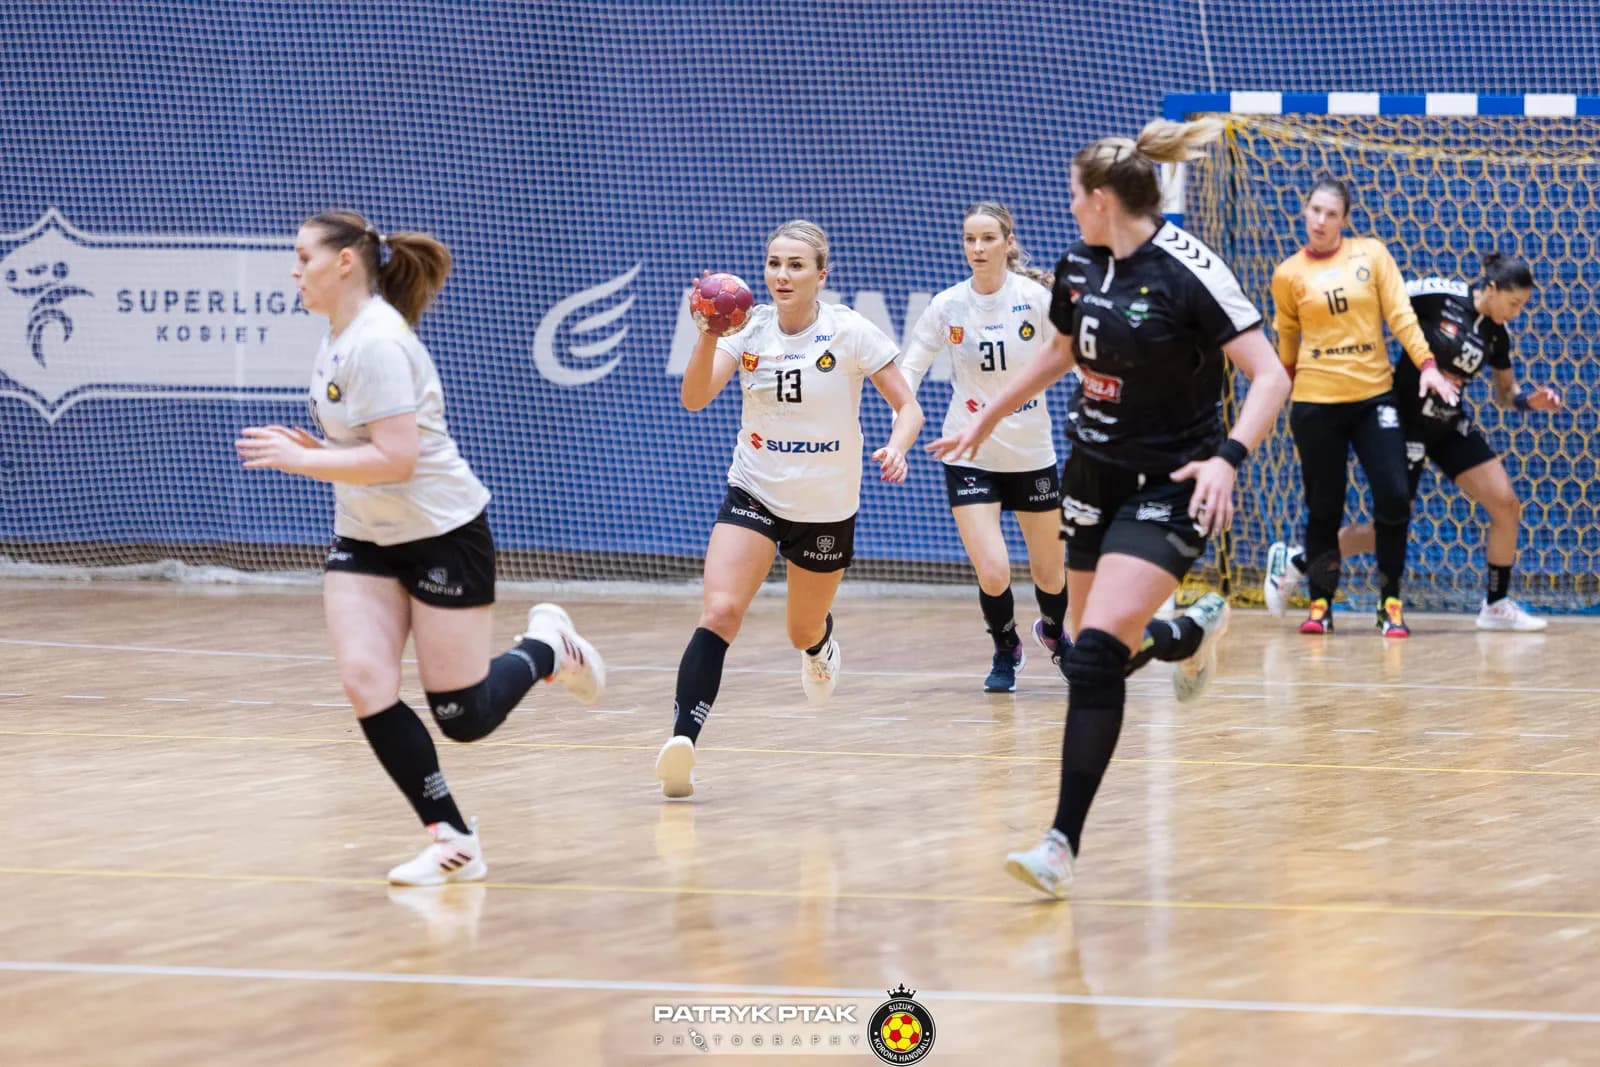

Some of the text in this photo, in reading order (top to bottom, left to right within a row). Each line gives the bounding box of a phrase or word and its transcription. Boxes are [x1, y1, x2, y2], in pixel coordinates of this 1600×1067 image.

[116, 289, 309, 315] SUPERLIGA
[1324, 287, 1348, 315] 16
[156, 325, 270, 343] KOBIET
[1079, 315, 1099, 360] 6
[979, 341, 1007, 371] 31
[775, 369, 802, 403] 13
[766, 439, 840, 453] SUZUKI
[803, 550, 844, 561] PROFIKA
